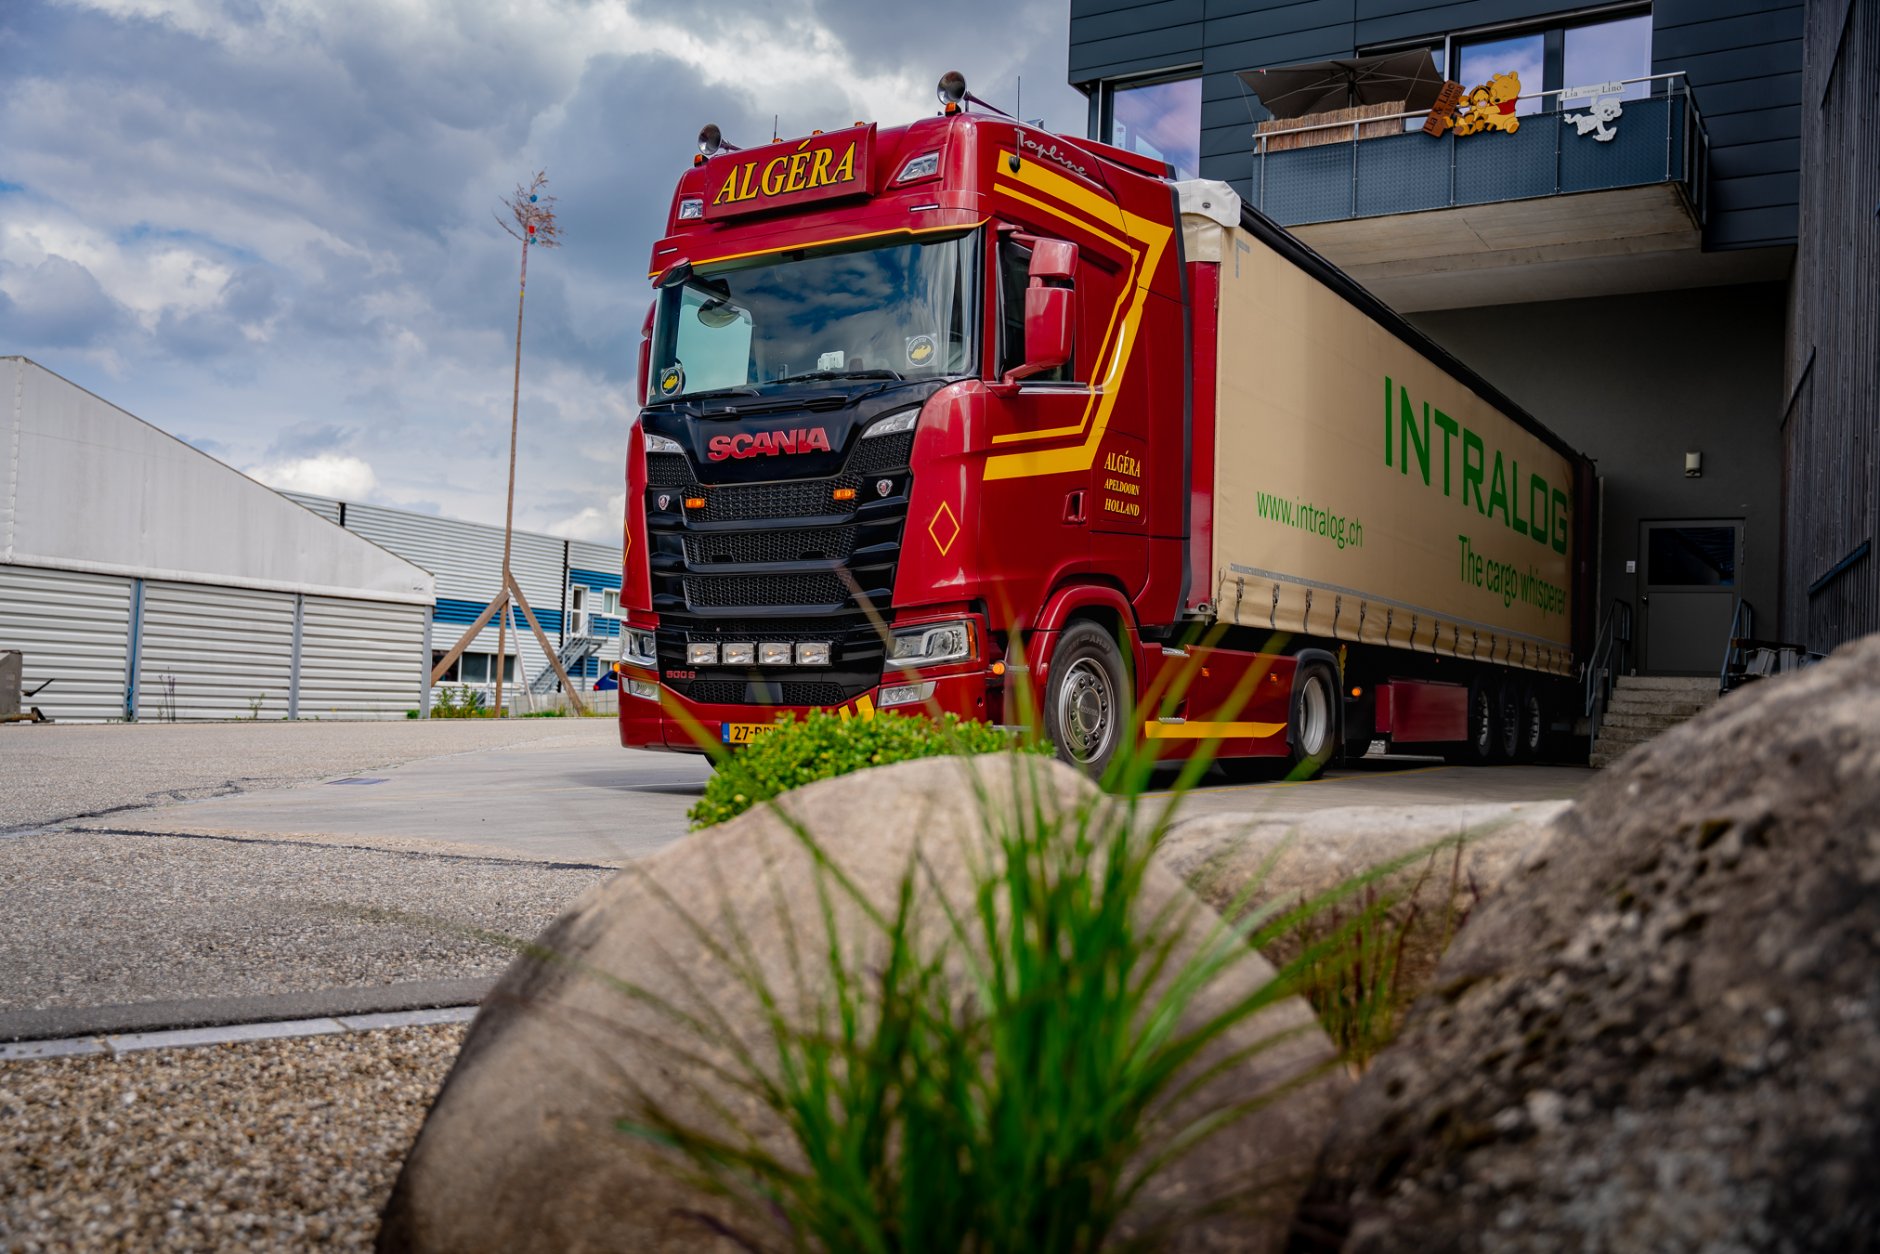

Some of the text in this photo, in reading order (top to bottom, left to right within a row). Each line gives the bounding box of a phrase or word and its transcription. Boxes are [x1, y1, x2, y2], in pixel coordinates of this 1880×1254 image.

[1602, 81, 1622, 93] Lino
[712, 138, 857, 205] ALGÉRA
[1013, 126, 1088, 176] Topline
[707, 426, 832, 462] SCANIA
[1103, 450, 1141, 478] ALGÉRA
[1103, 478, 1140, 496] APELDOORN
[1385, 376, 1567, 556] INTRALOG
[1104, 498, 1140, 517] HOLLAND
[1257, 491, 1363, 549] www.intralog.ch
[1458, 534, 1566, 618] The cargo whisperer
